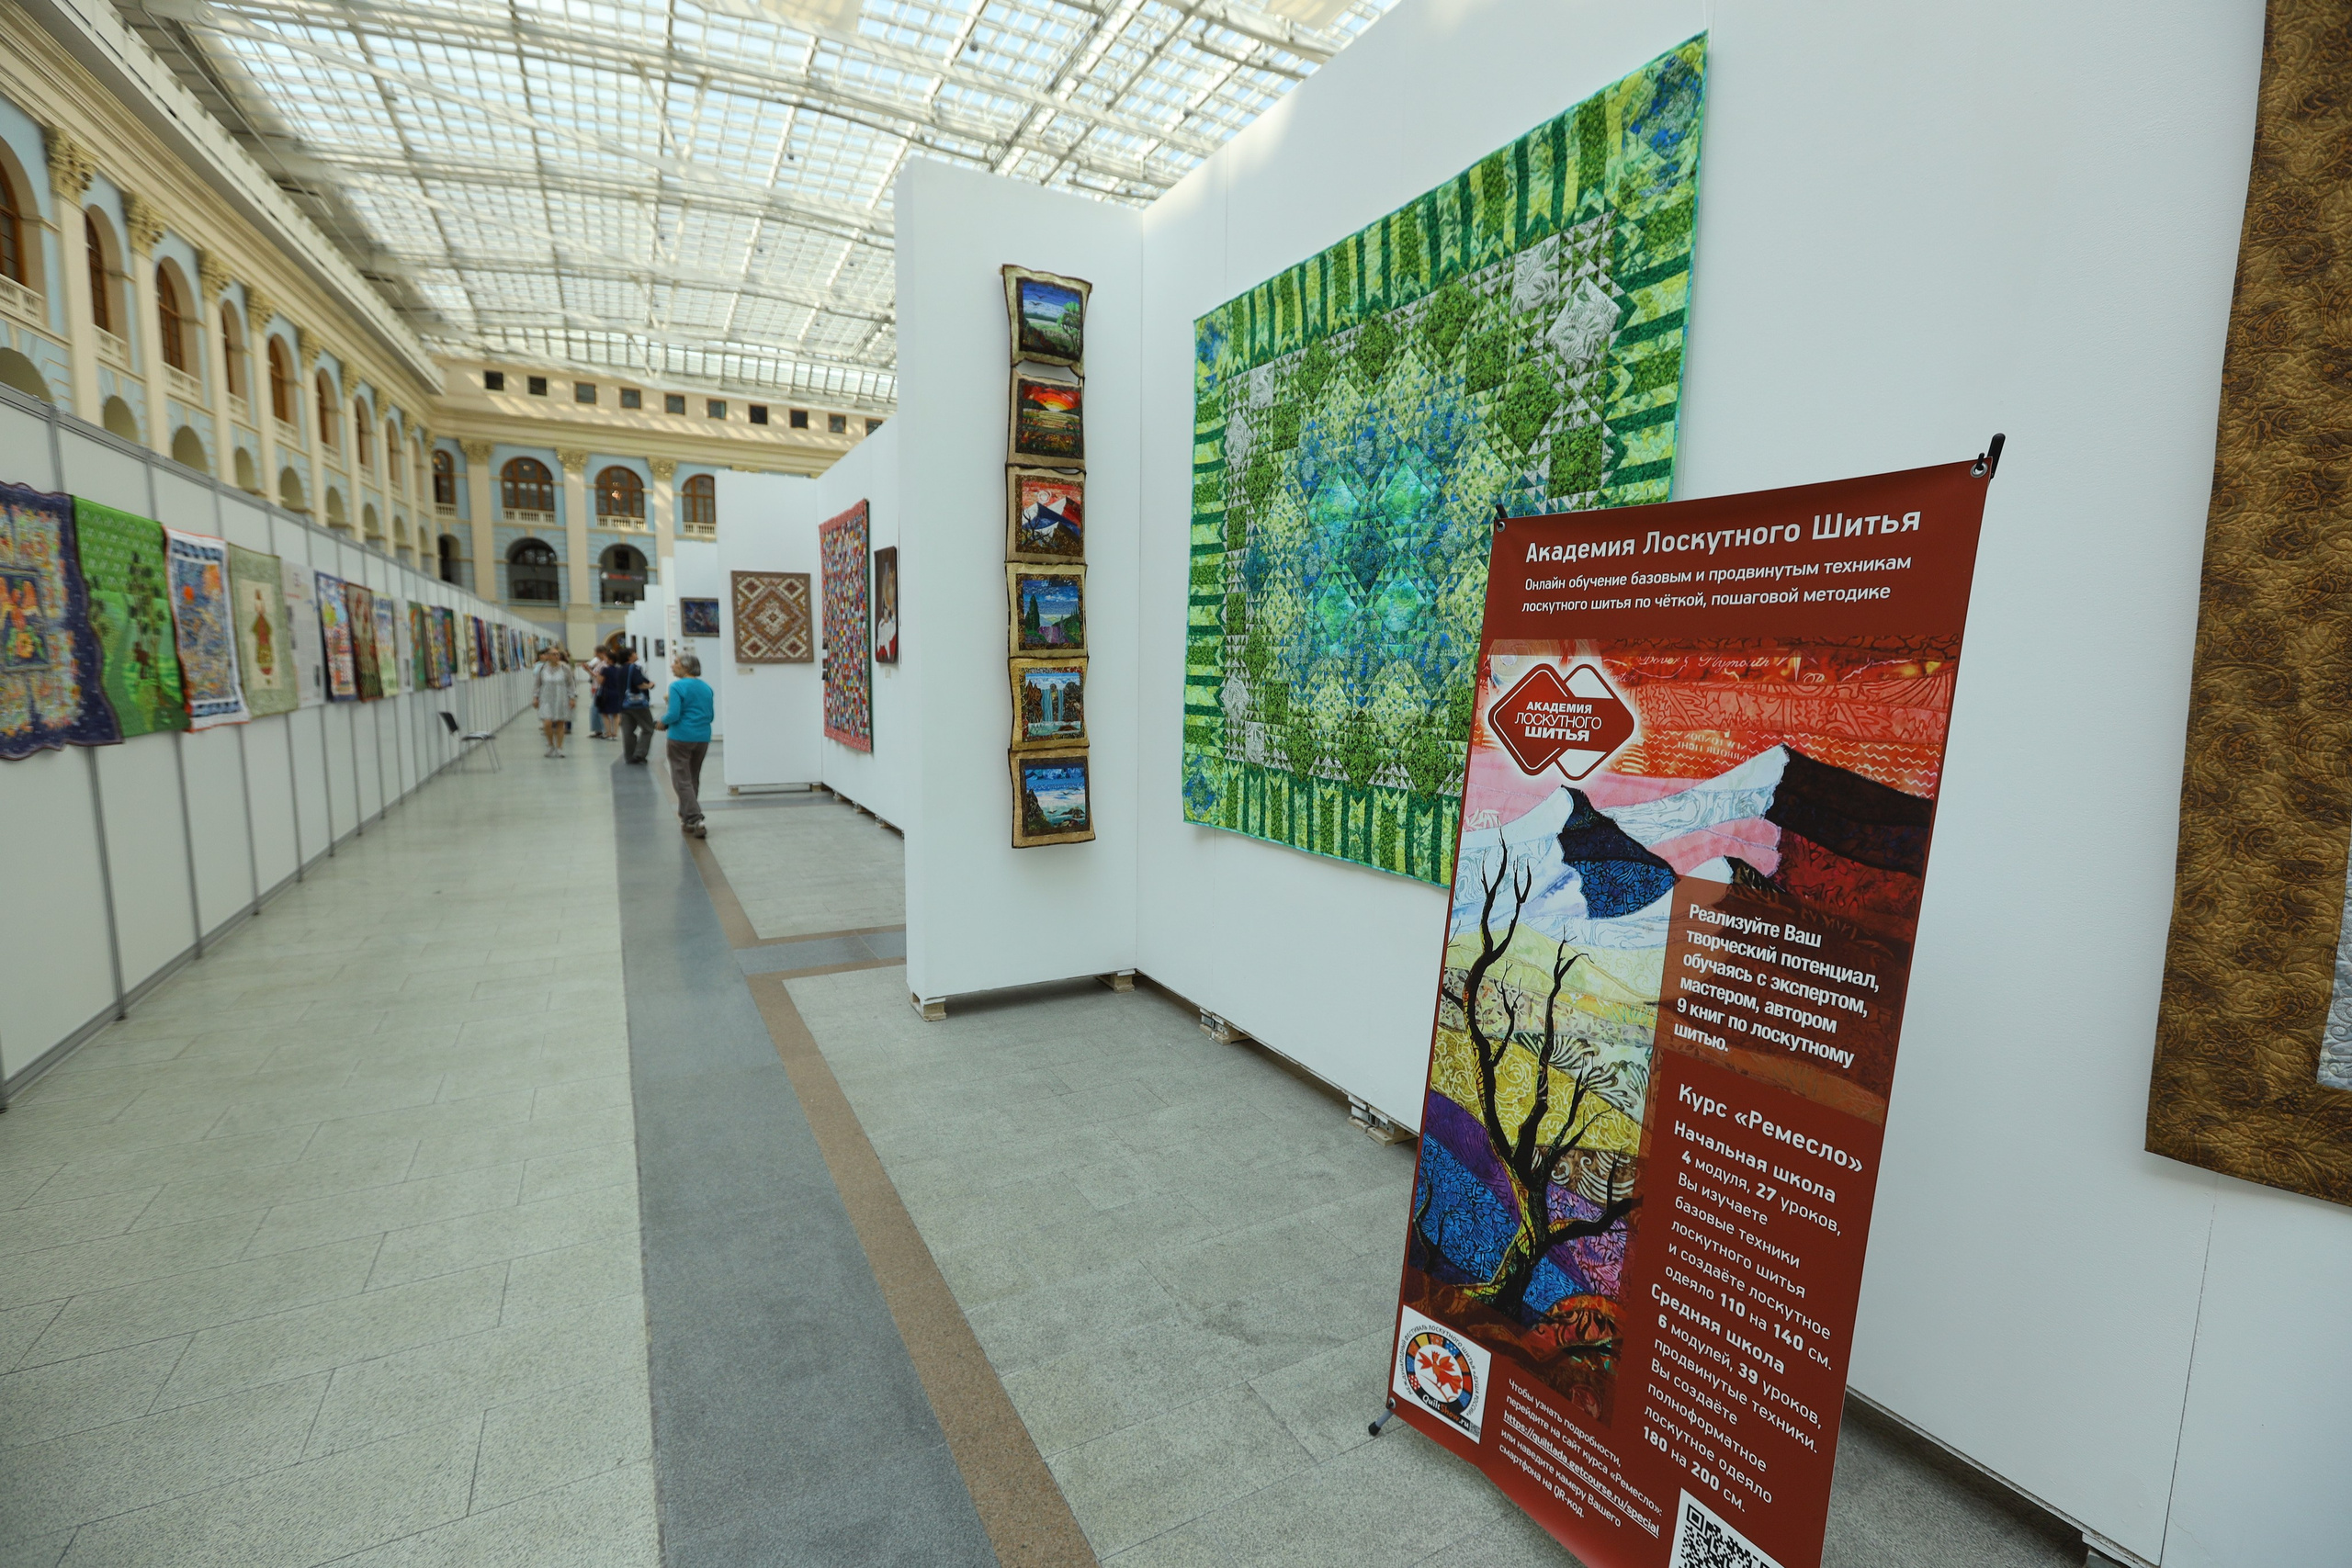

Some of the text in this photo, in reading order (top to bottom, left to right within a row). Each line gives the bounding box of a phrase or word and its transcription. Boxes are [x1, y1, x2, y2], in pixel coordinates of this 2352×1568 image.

[1525, 511, 1921, 563] Академия Лоскутного Шитья
[1521, 586, 1891, 615] лоскутного шитья по чёткой, пошаговой методике
[1525, 557, 1912, 591] Онлайн обучение базовым и продвинутым техникам
[1699, 656, 1770, 673] Plymouth
[1514, 712, 1602, 730] ЛОСКУТНОГО
[1524, 726, 1590, 742] ШИТЬЯ
[1526, 701, 1592, 714] АКАДЕМИЯ
[1686, 930, 1880, 992] творческий потенциал,
[1689, 903, 1822, 948] Реализуйте Ваш
[1680, 976, 1838, 1033] мастером, автором
[1683, 953, 1868, 1017] обучаясь с экспертом,
[1673, 1022, 1729, 1052] шитью.
[1677, 998, 1855, 1069] 9 книг по лоскутному
[1674, 1120, 1837, 1203] Начальная школа
[1679, 1083, 1862, 1172] Курс «Ремесло»
[1678, 1172, 1768, 1225] Вы изучаете
[1681, 1150, 1841, 1236] 4 модуля, 27 уроков,
[1671, 1221, 1806, 1299] лоскутного шитья
[1675, 1196, 1801, 1269] базовые техники
[1665, 1266, 1832, 1371] одеяло 110 на 140 см.
[1668, 1243, 1831, 1340] и создаёте лоскутное
[1405, 1325, 1428, 1340] ФЕСТИВАЛЬ
[1429, 1325, 1463, 1348] ЛОСКУТНОГО
[1462, 1347, 1476, 1370] ШИТЬЯ
[1651, 1283, 1785, 1374] Средняя школа
[1651, 1358, 1737, 1425] Вы создаёте
[1654, 1338, 1818, 1453] продвинутые техники.
[1657, 1314, 1821, 1429] 6 модулей, 39 уроков,
[1423, 1394, 1469, 1428] QuiltShow.ru
[1535, 1398, 1563, 1423] узнать
[1564, 1419, 1622, 1468] подробности,
[1647, 1383, 1767, 1472] полноформатное
[1498, 1444, 1585, 1518] смартфона на QR-код.
[1501, 1429, 1622, 1528] или наведите камеру Вашего
[1503, 1410, 1659, 1537] https://quiltlada.getcourse.ru/special
[1506, 1395, 1663, 1516] перейдите на сайт курса «Ремесло»:
[1644, 1405, 1773, 1504] лоскутное одеяло
[1644, 1426, 1746, 1513] 180 на 200 см.
